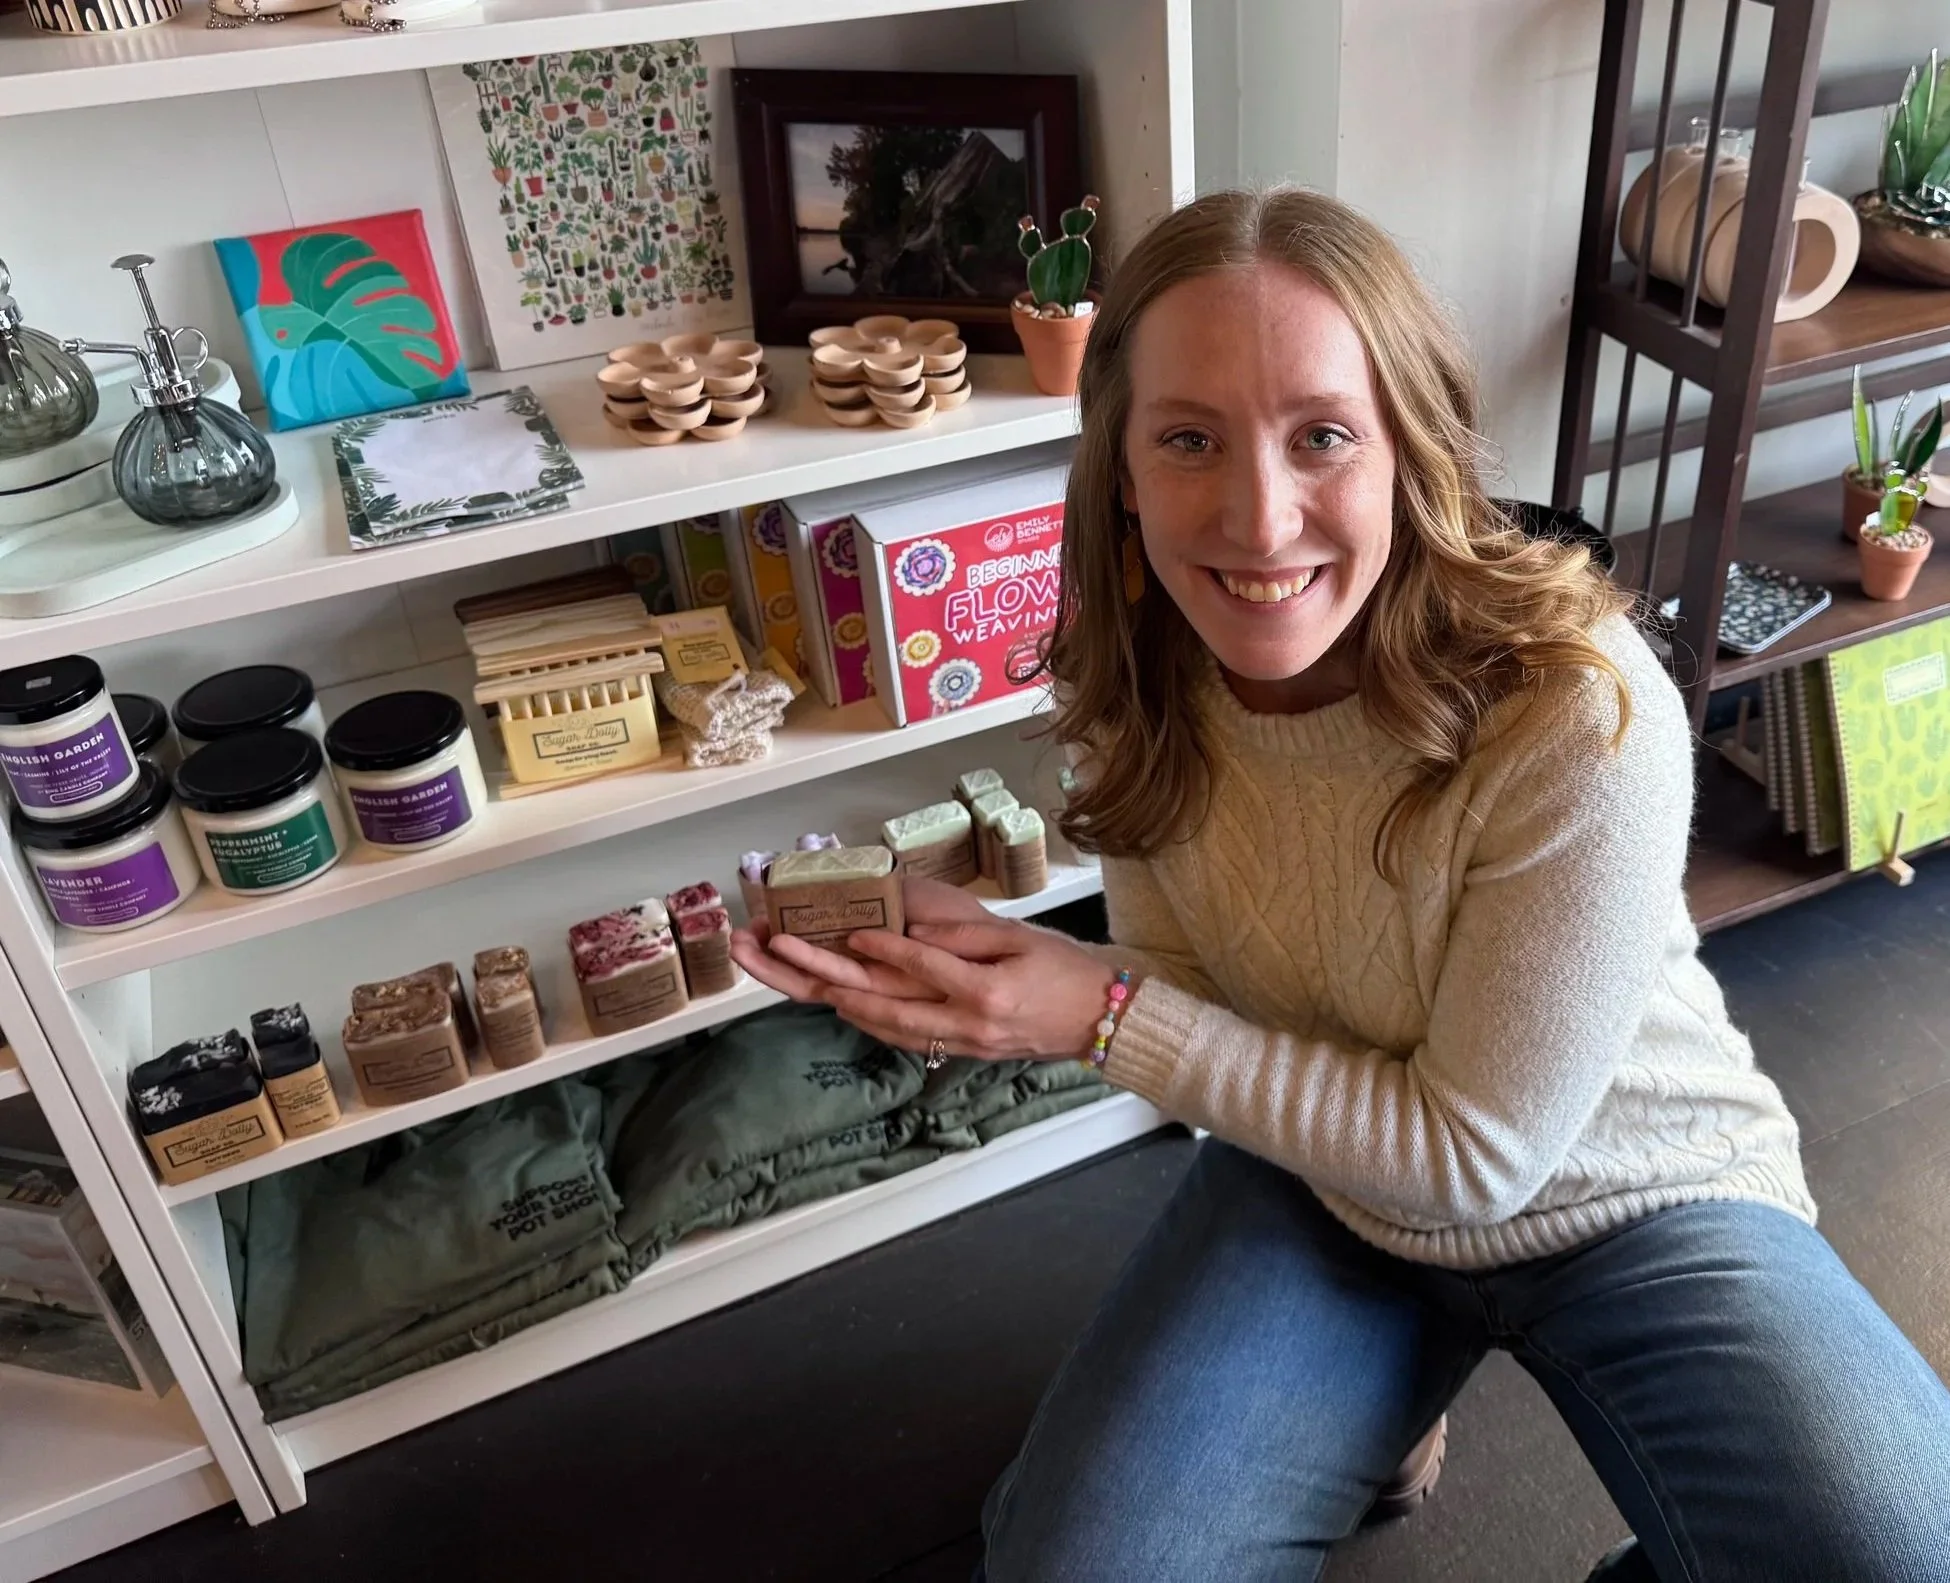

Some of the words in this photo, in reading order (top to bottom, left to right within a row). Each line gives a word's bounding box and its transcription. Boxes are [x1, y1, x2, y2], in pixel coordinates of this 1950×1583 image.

[1016, 515, 1050, 529] EMILY
[54, 732, 104, 760] GARDEN
[542, 733, 581, 748] Sugar
[584, 726, 618, 739] Dolly
[55, 767, 69, 776] LILY
[81, 758, 92, 767] THE
[353, 794, 398, 806] ENGLISH
[401, 782, 448, 803] GARDEN
[209, 832, 279, 847] PEPPERMINT
[214, 841, 282, 857] EUCALYPTUS
[42, 875, 103, 888] LAVENDER
[790, 910, 832, 926] Sugar
[839, 904, 878, 920] Dolly
[174, 1138, 215, 1156] Sugar
[828, 1129, 862, 1149] POT
[490, 1201, 545, 1231] YOUR
[508, 1213, 546, 1241] POT
